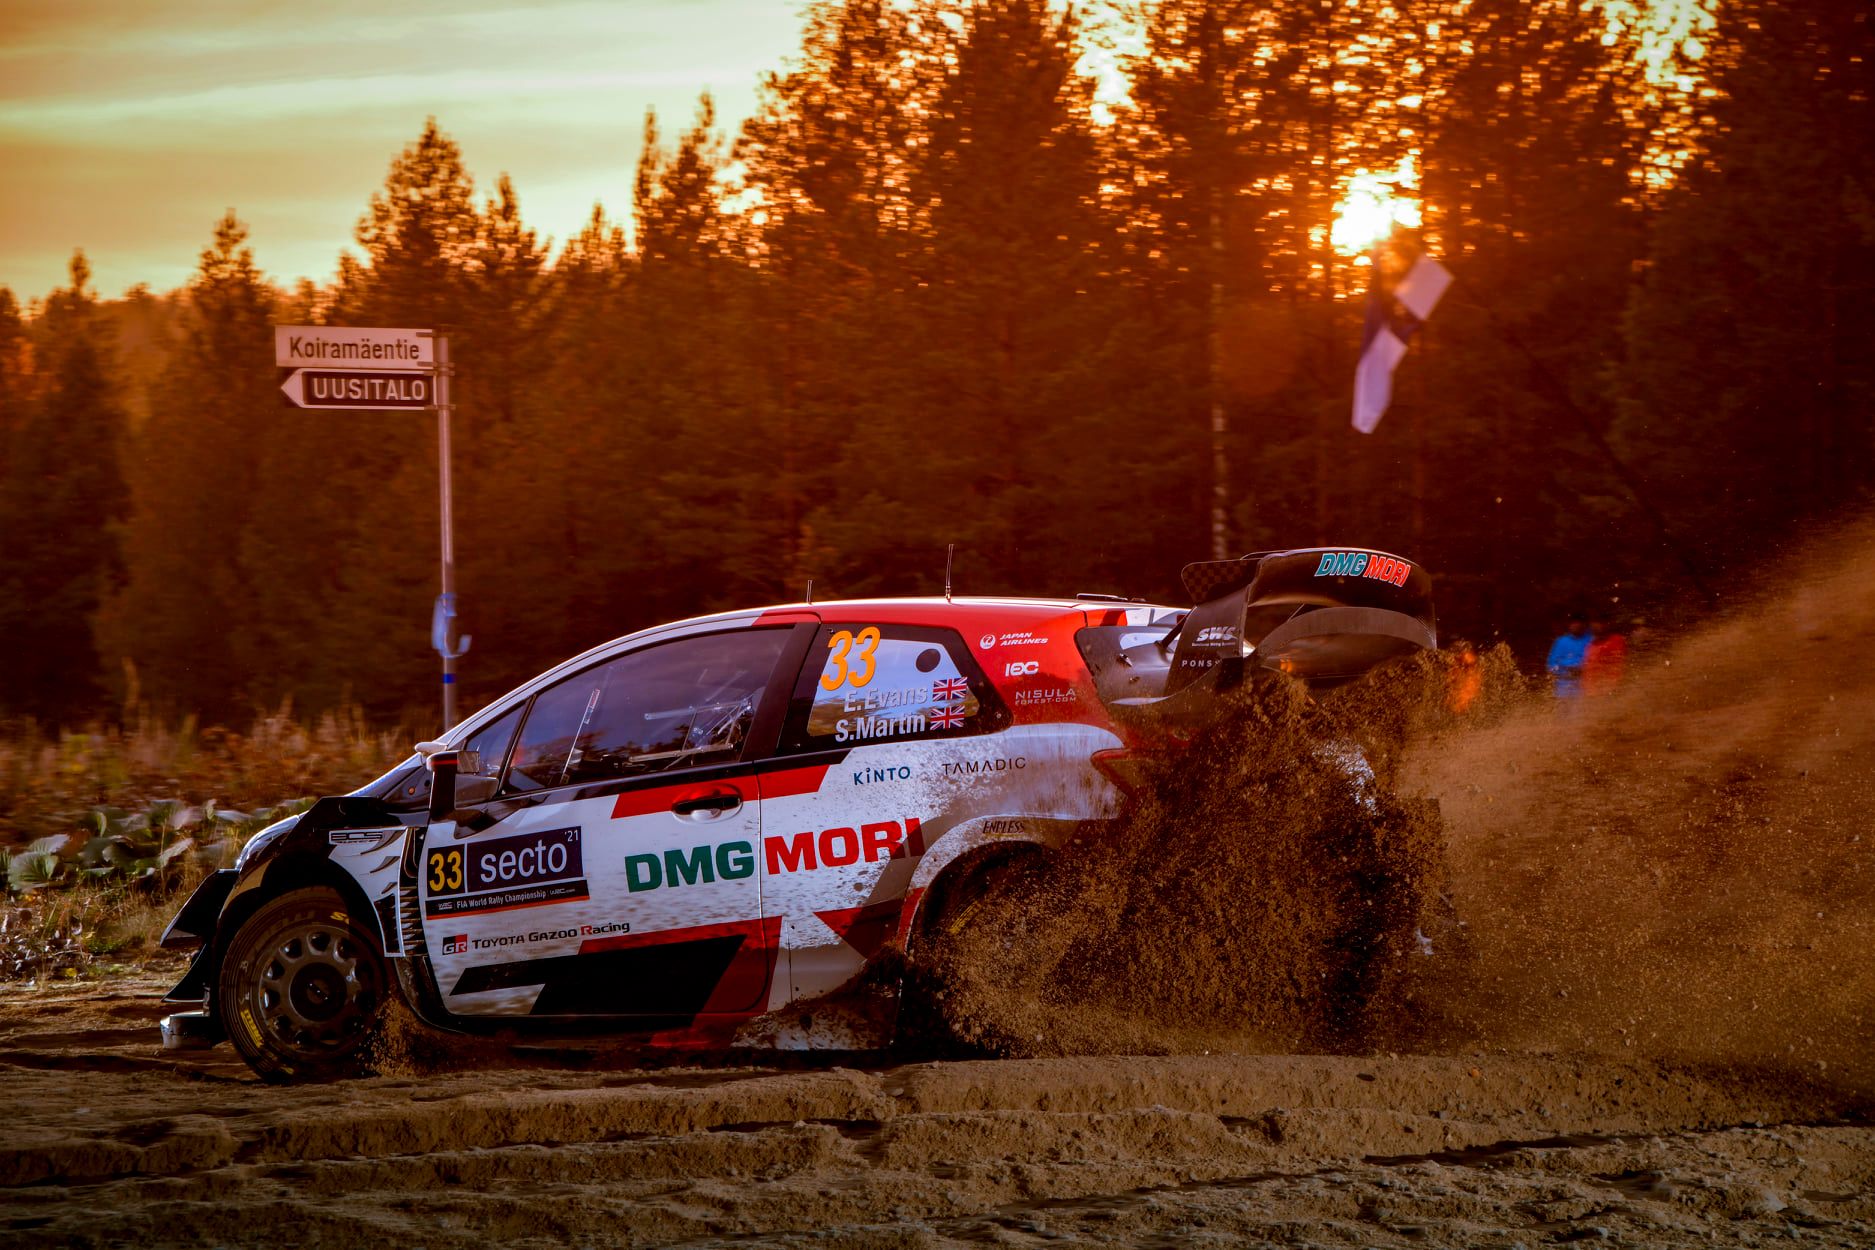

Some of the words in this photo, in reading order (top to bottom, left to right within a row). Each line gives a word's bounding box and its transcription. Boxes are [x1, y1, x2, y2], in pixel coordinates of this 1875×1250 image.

[290, 337, 419, 360] Koiramäentie
[313, 378, 425, 400] UUSITALO
[1314, 553, 1368, 577] DMG
[1362, 554, 1411, 587] MORI
[1000, 631, 1033, 640] JAPAN
[1000, 638, 1049, 647] AIRLINES
[820, 626, 881, 691] 33
[844, 687, 928, 713] E.Evans
[1015, 688, 1076, 700] NISULA
[834, 712, 926, 743] S.Martin
[942, 757, 1027, 776] TAMADIC
[982, 820, 1026, 834] ENDLESS
[429, 850, 463, 892] 33
[480, 839, 567, 883] secto
[624, 840, 755, 893] DMG
[764, 817, 925, 876] MORI
[456, 900, 468, 909] FIA
[469, 897, 488, 907] World
[488, 895, 504, 905] Rally
[504, 889, 546, 903] Championship
[443, 941, 467, 954] GR
[471, 936, 525, 949] TOYOTA
[529, 928, 577, 942] GAZOO
[580, 922, 631, 937] Racing
